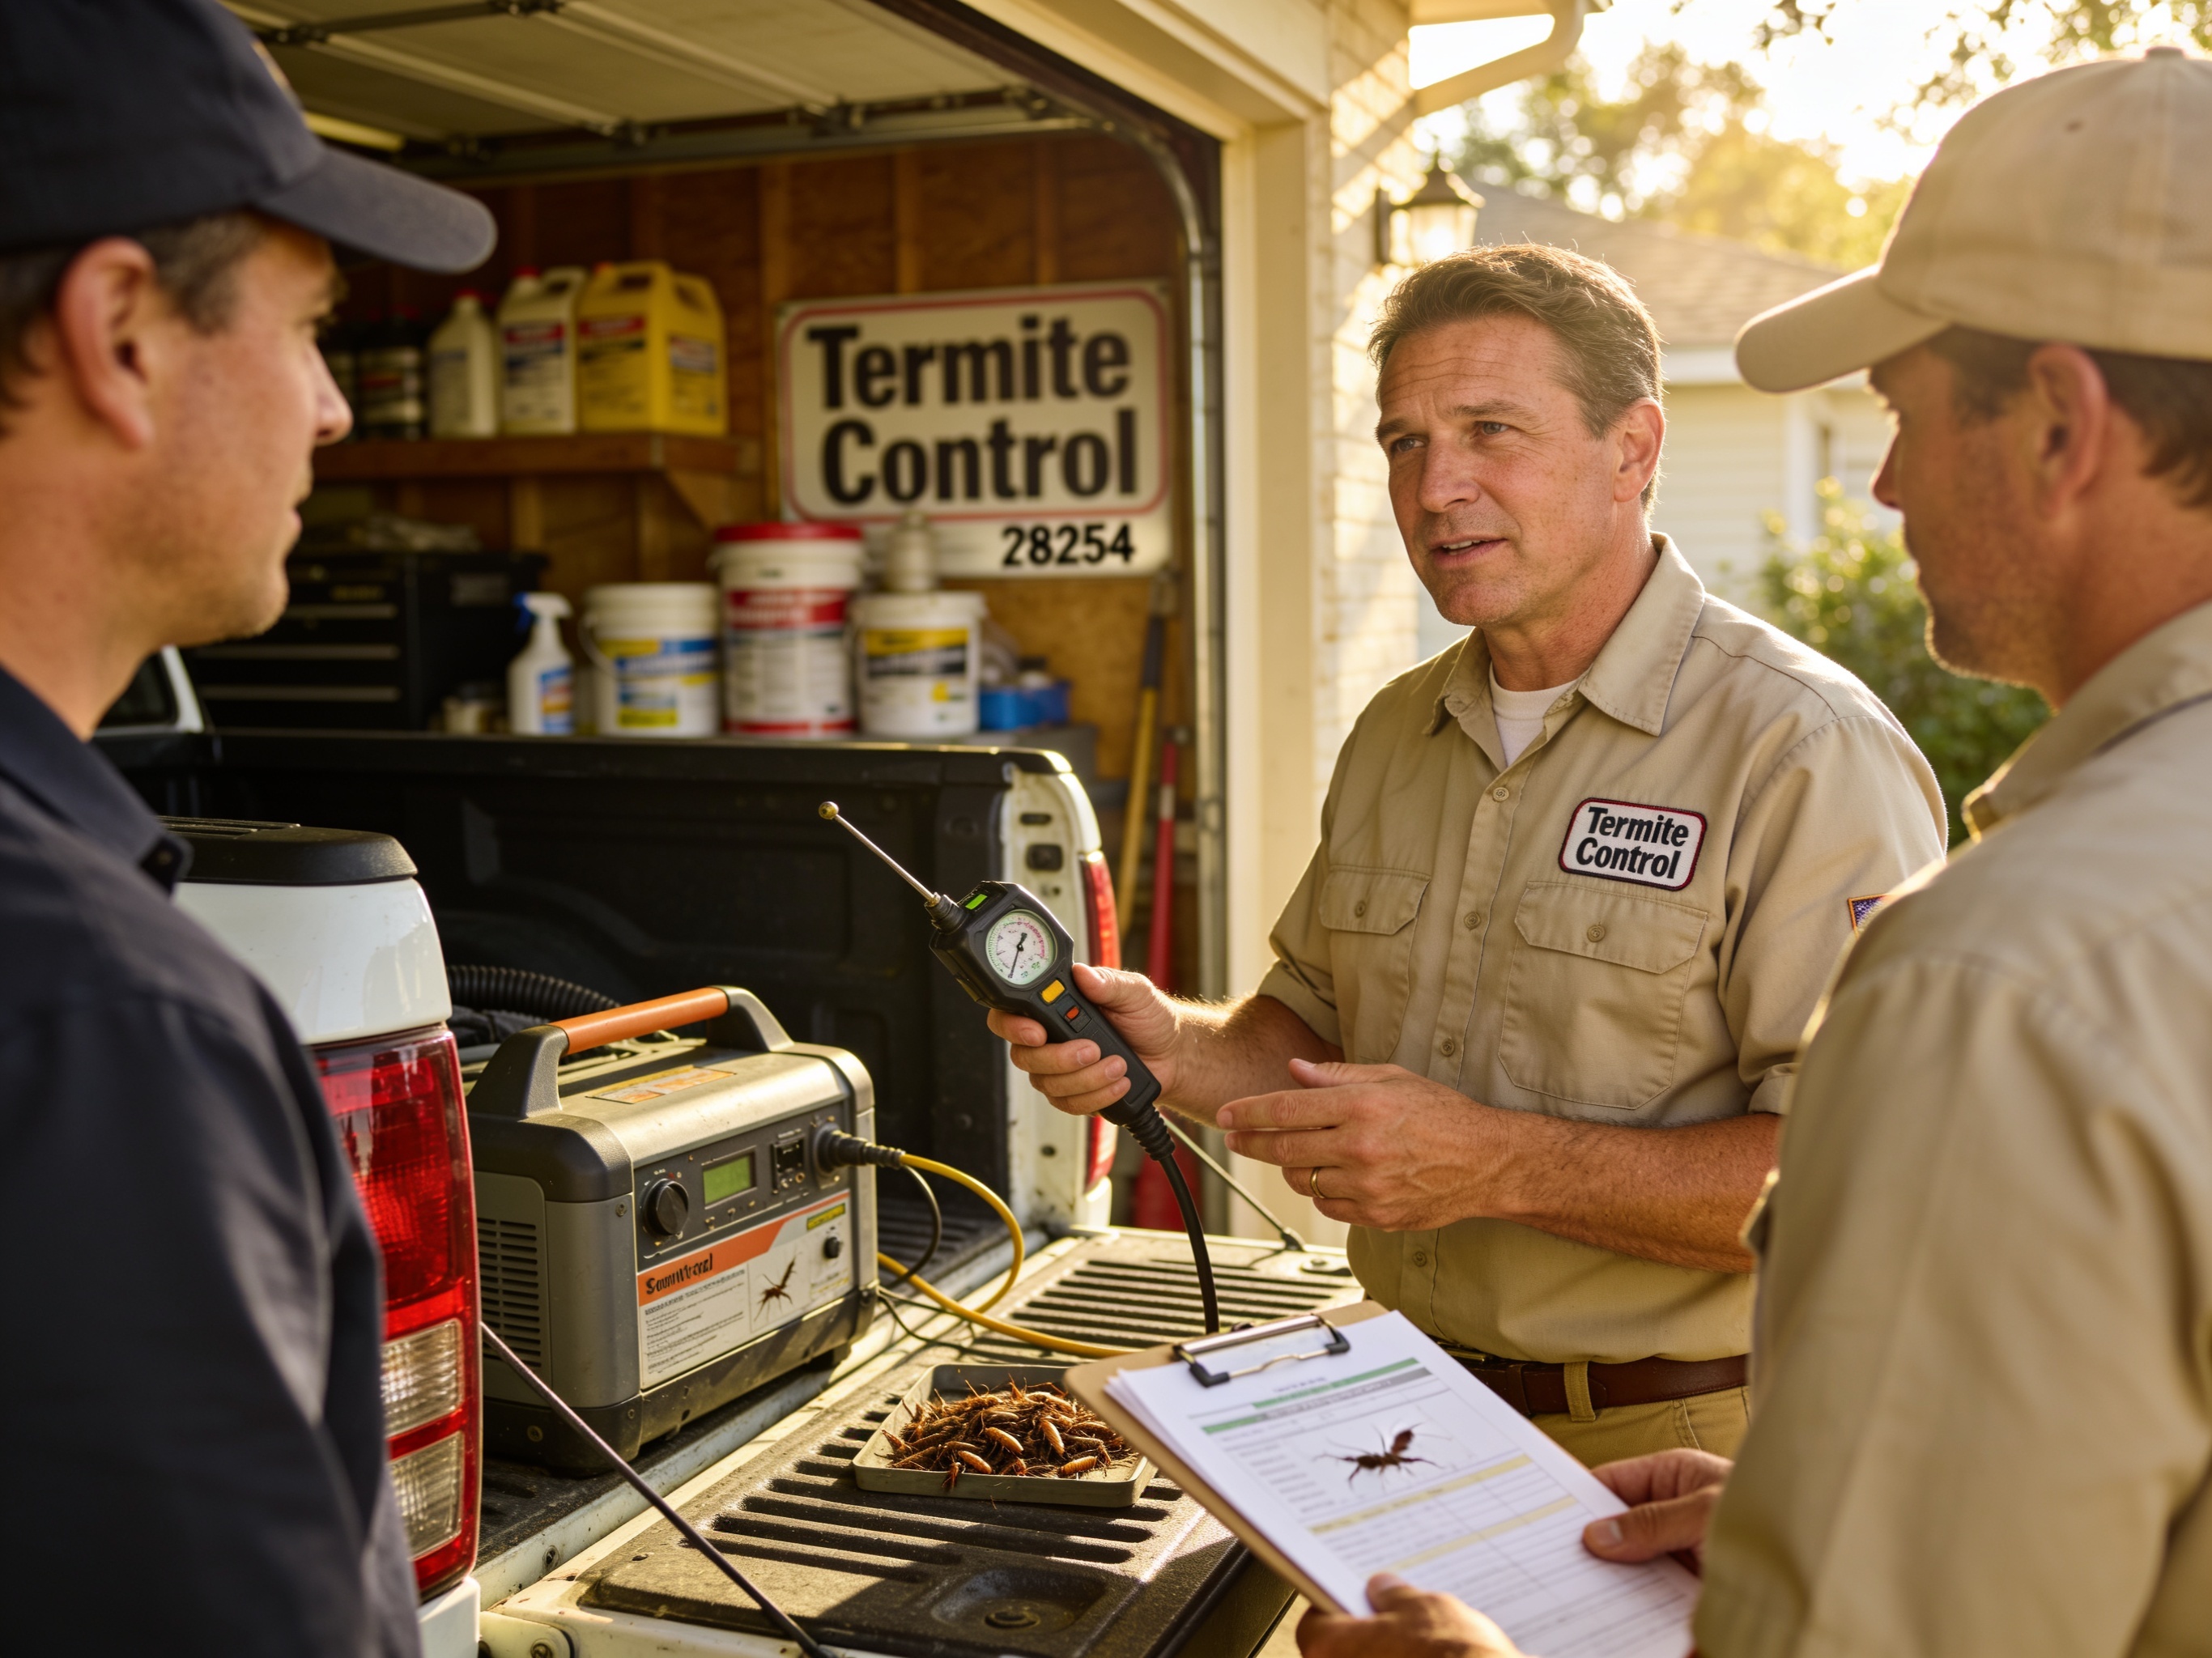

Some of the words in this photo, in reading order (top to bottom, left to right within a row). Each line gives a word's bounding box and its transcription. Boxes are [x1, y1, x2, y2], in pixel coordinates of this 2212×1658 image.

[806, 315, 1129, 410] Termite
[821, 409, 1136, 506] Control
[1002, 525, 1134, 567] 28254
[1589, 806, 1689, 847] Termite
[1576, 837, 1682, 879] Control
